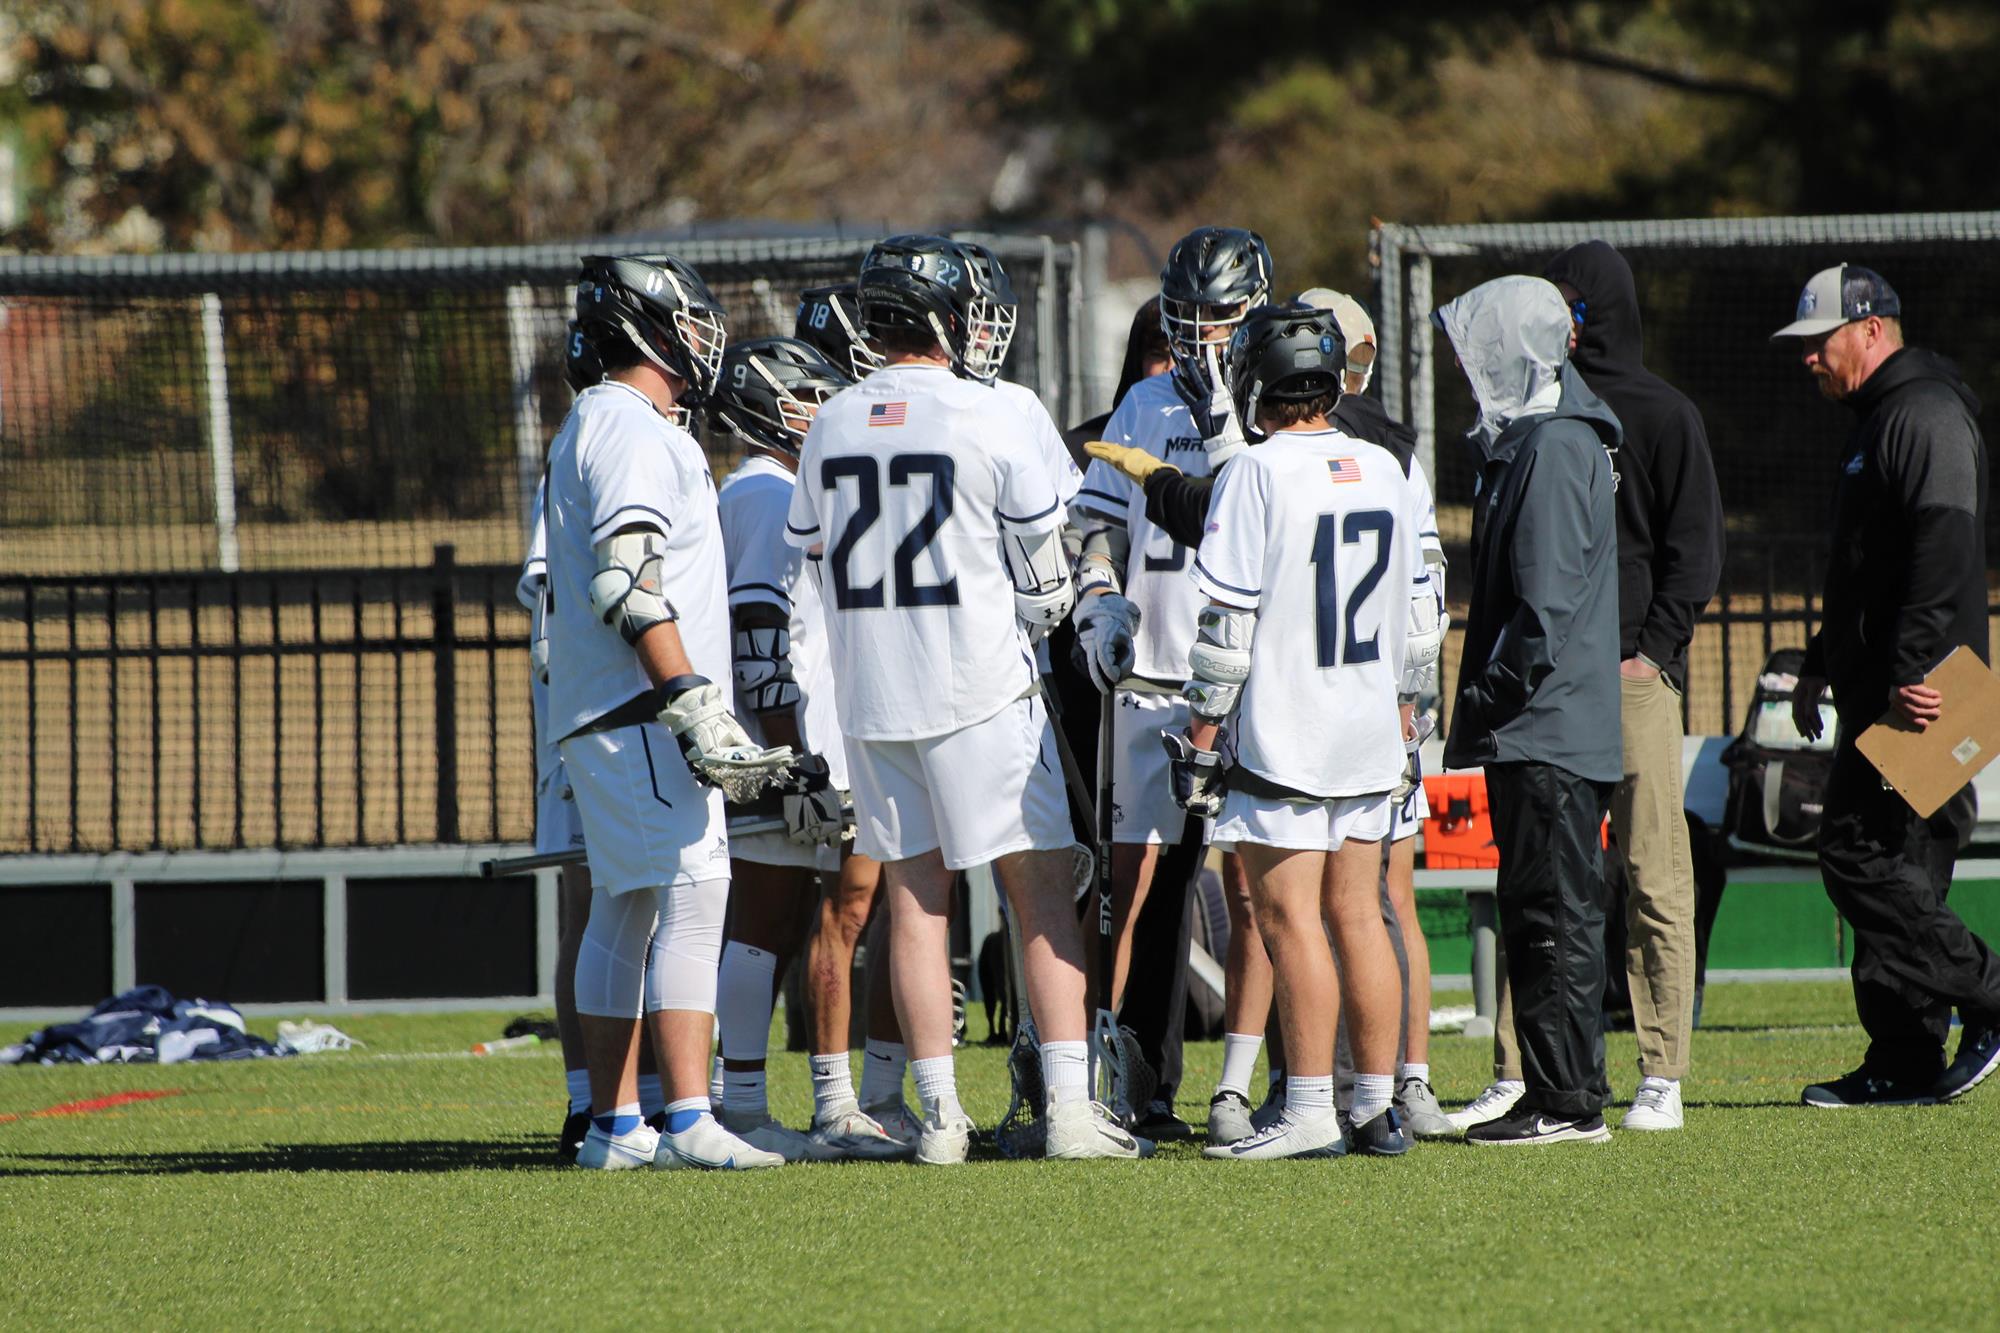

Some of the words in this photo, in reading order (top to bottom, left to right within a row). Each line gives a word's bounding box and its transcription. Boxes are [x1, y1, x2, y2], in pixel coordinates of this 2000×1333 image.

[935, 258, 960, 292] 22
[808, 302, 830, 330] 18
[571, 331, 585, 359] 5
[732, 363, 748, 390] 9
[1164, 435, 1207, 460] MAR
[821, 452, 961, 609] 22
[1309, 507, 1394, 670] 12
[1100, 892, 1112, 936] STX
